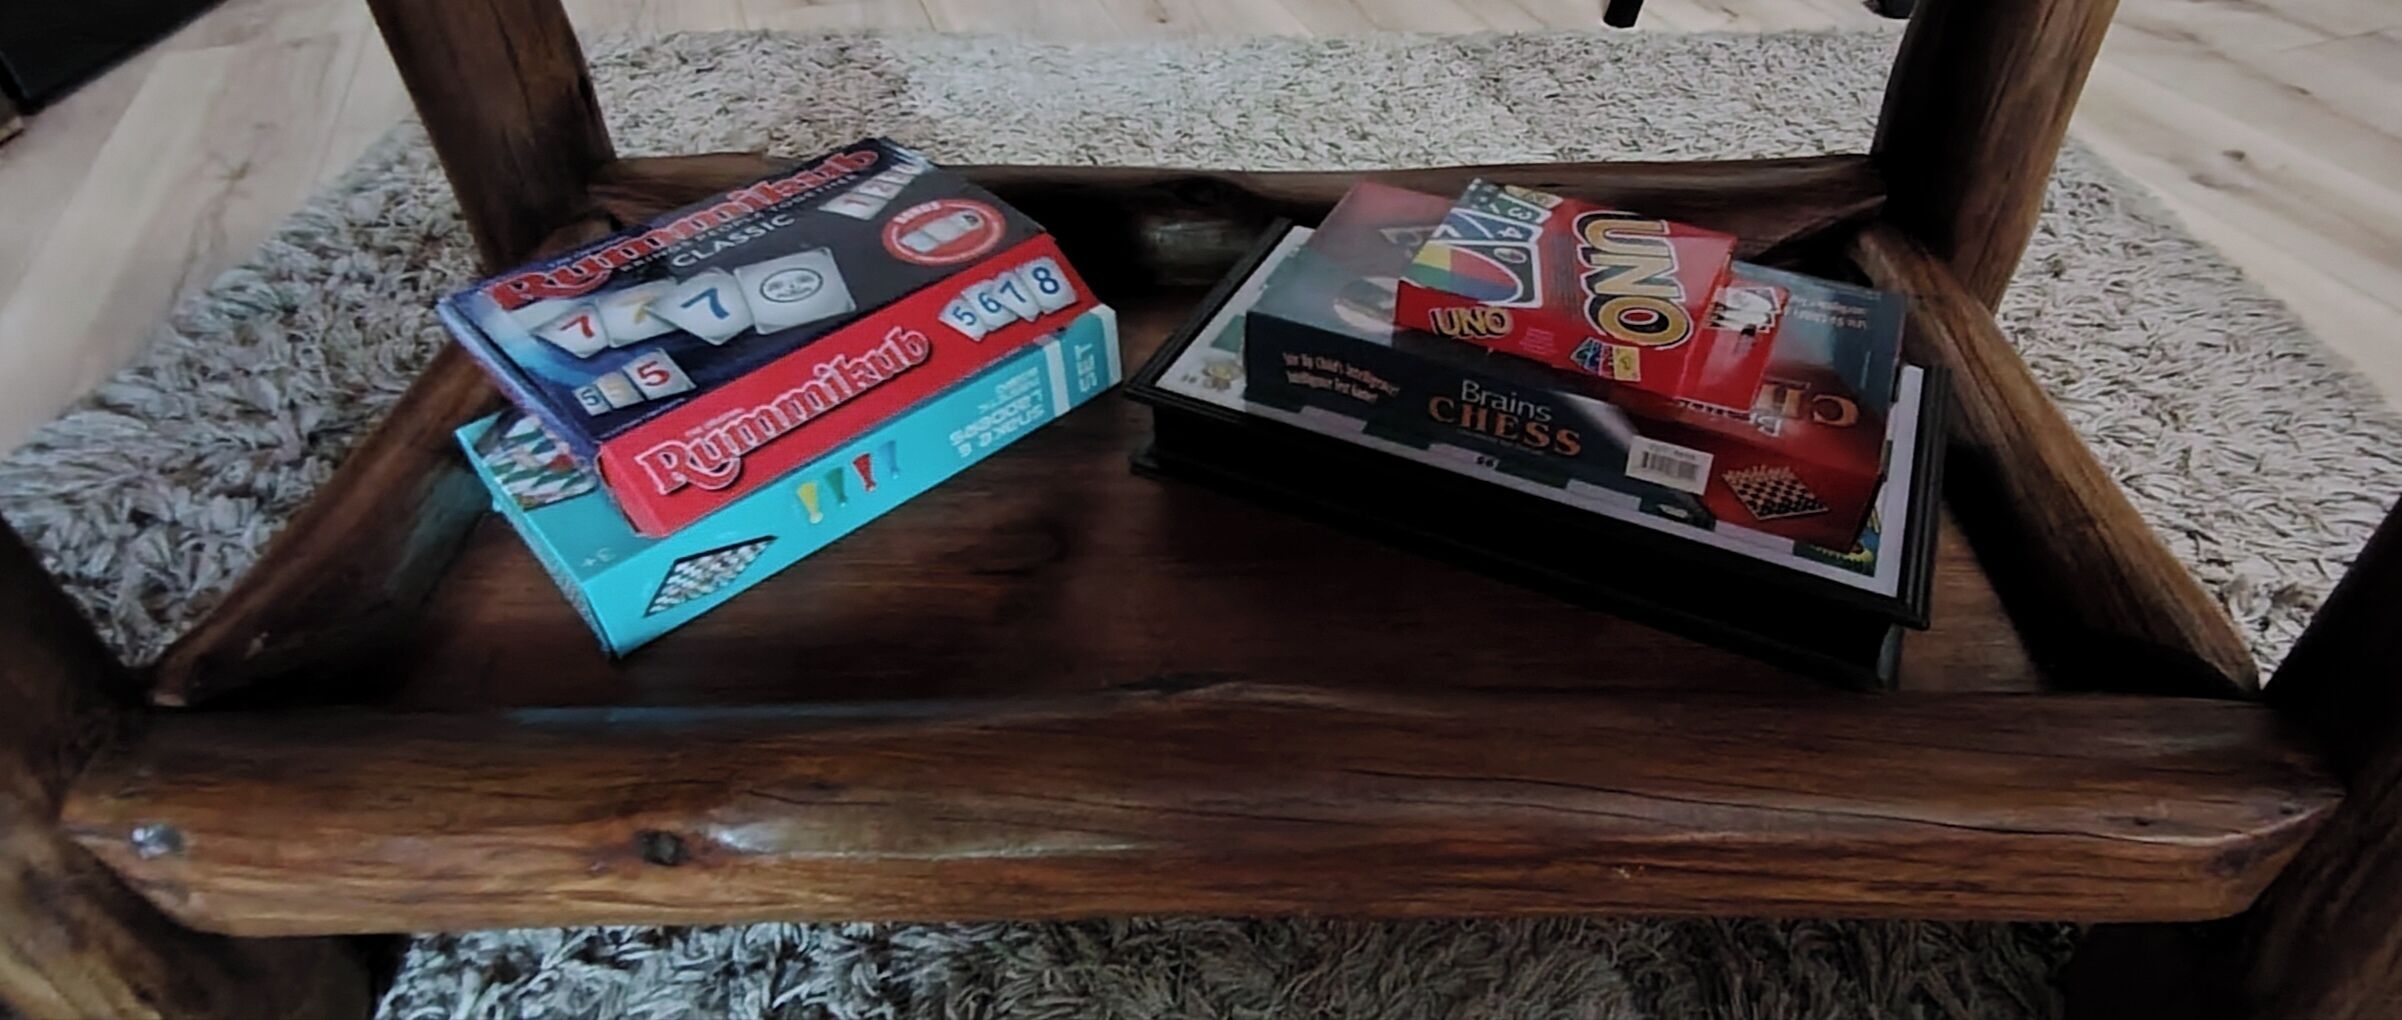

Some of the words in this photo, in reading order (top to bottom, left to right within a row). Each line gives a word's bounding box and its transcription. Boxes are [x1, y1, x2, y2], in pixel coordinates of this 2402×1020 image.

[482, 150, 878, 311] Rummikub
[671, 213, 796, 267] CLASSIC
[952, 306, 977, 326] 5
[978, 292, 1002, 313] 6
[999, 280, 1026, 303] 7
[1032, 266, 1060, 294] 8
[1573, 211, 1693, 350] UNO
[559, 315, 595, 338] 7
[680, 287, 730, 320] 7
[1429, 306, 1513, 339] UNO
[637, 360, 670, 386] 5
[1074, 343, 1098, 392] SET
[634, 326, 930, 495] Rummikub
[1428, 396, 1581, 456] CHESS
[1461, 379, 1553, 422] Brains
